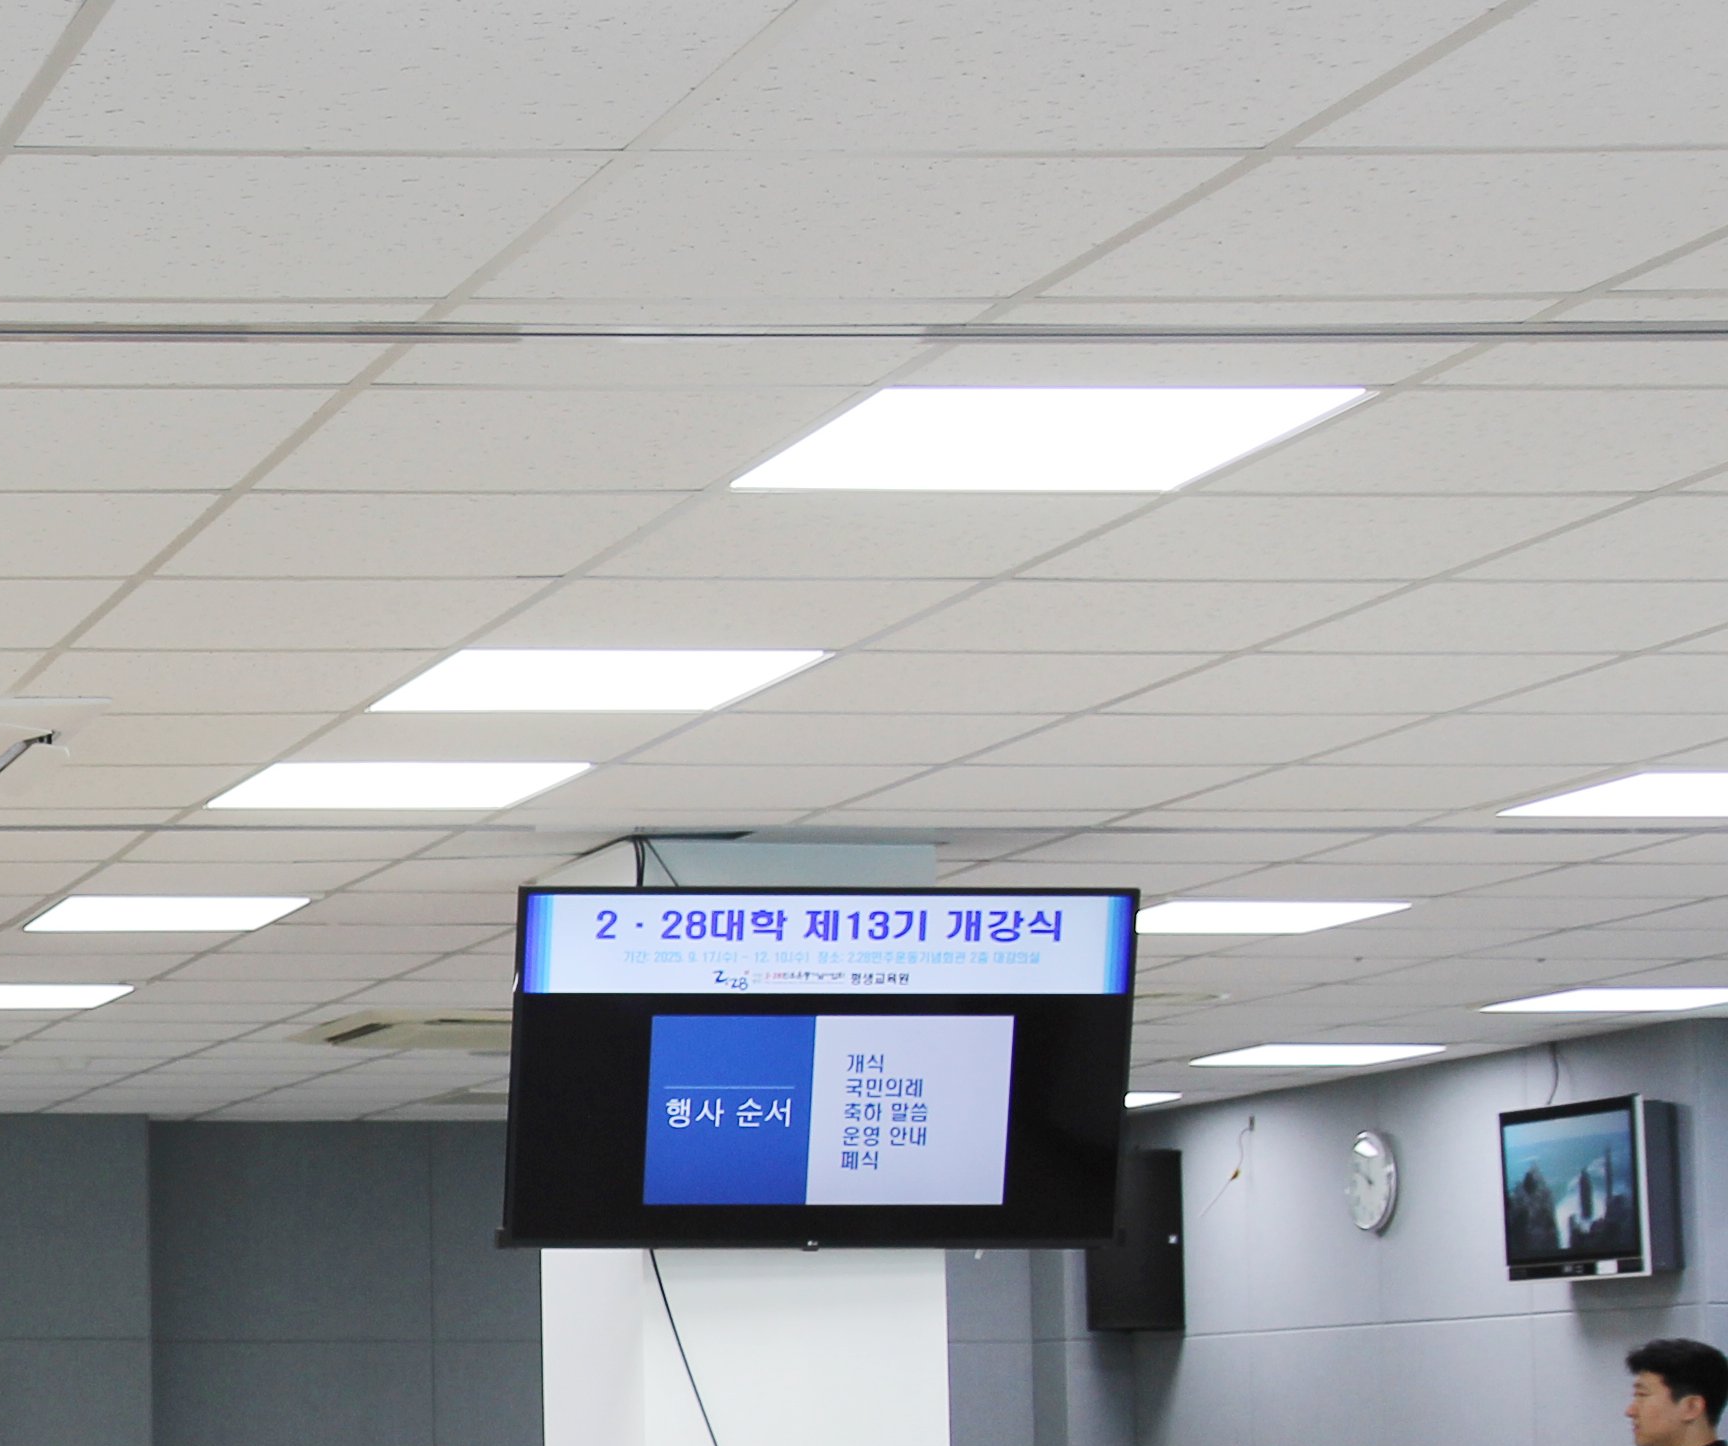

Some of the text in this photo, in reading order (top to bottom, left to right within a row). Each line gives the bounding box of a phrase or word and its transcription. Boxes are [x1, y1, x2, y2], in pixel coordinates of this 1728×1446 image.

[595, 909, 619, 940] 2
[660, 908, 789, 942] 28대학
[803, 909, 928, 943] 제13기
[946, 909, 1063, 944] 개강식
[847, 1053, 885, 1074] 개식
[845, 1077, 924, 1099] 국민의례
[664, 1096, 793, 1130] 행사 순서
[844, 1101, 929, 1123] 축하 말씀
[842, 1125, 928, 1148] 운영 안내
